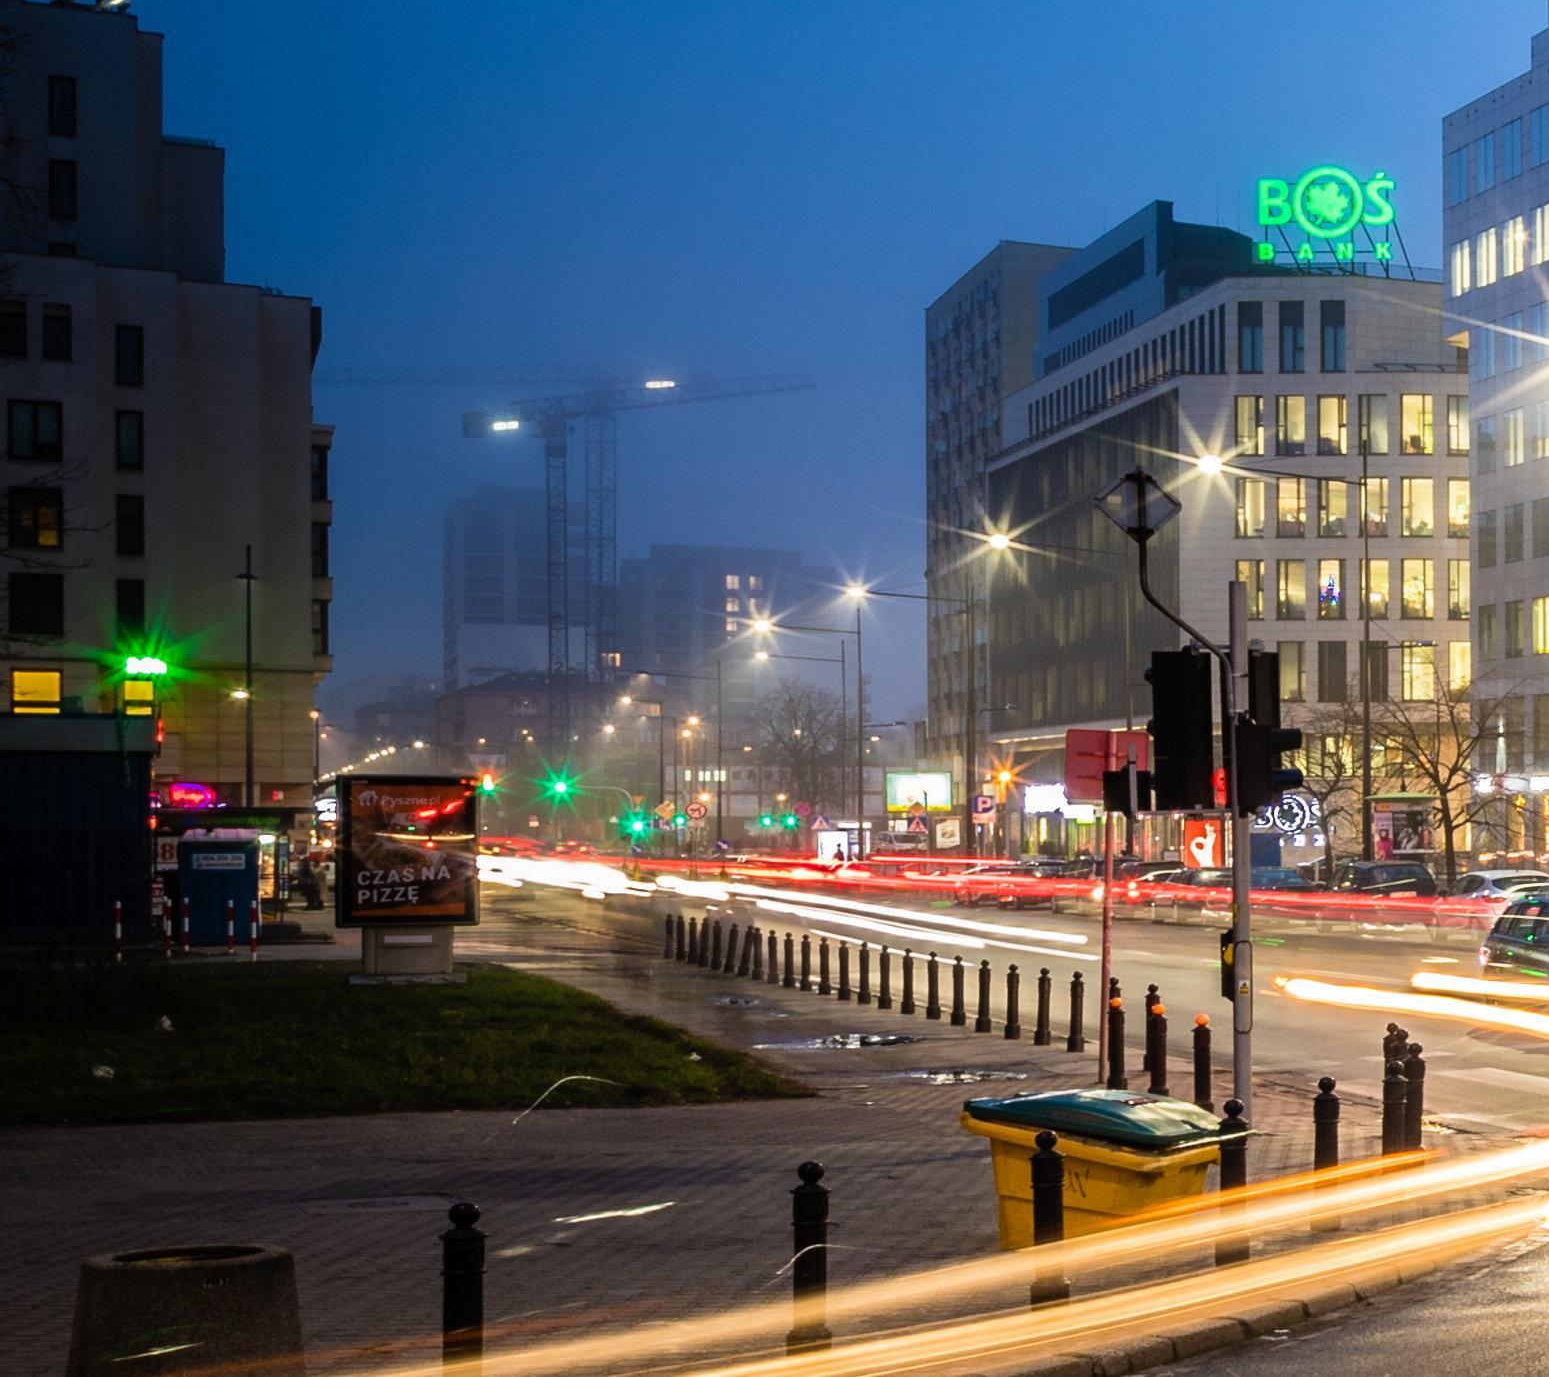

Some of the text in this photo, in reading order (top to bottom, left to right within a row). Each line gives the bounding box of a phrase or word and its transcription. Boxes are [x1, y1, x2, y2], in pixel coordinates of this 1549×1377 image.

[1258, 165, 1395, 238] BOŚ
[1257, 242, 1392, 260] BANK
[381, 795, 441, 808] Pyszne.pl
[977, 796, 992, 812] P
[357, 865, 451, 886] CZAS NA
[357, 885, 420, 904] PIZZĘ
